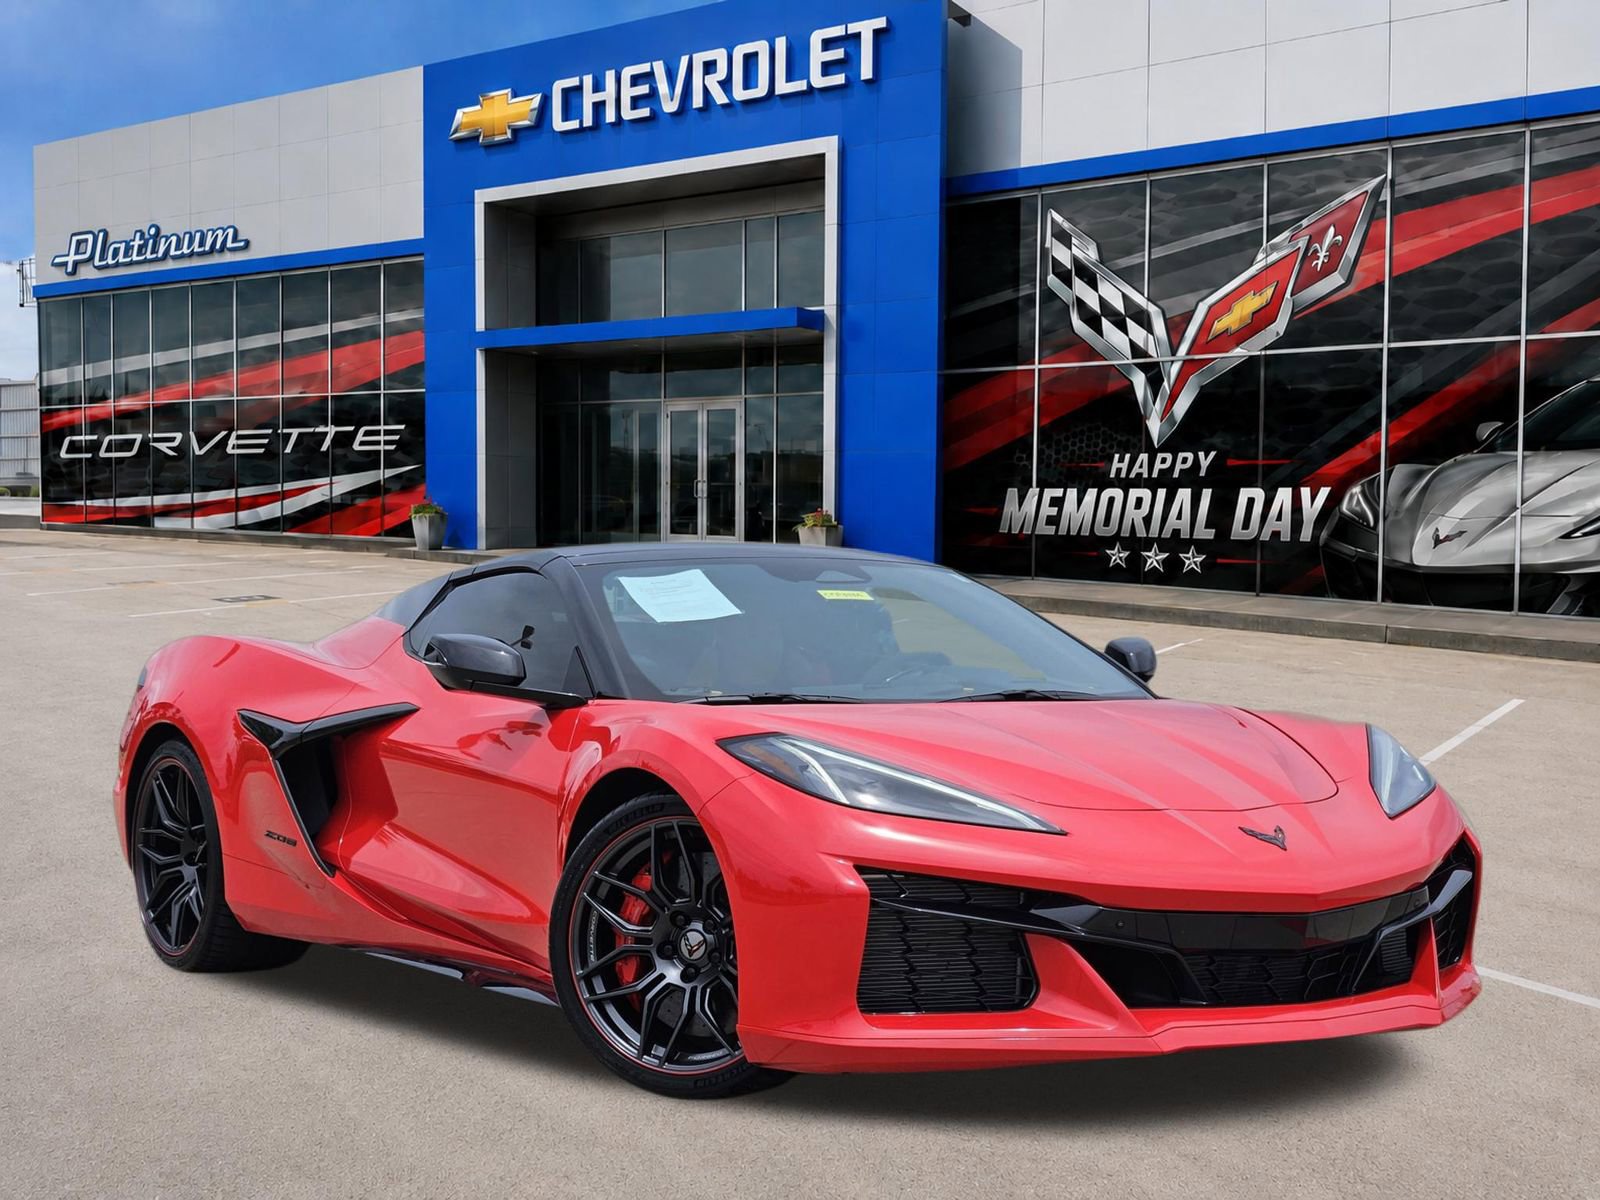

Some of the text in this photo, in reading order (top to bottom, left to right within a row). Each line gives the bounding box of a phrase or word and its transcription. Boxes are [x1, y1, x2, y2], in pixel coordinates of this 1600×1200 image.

[551, 16, 888, 132] CHEVROLET
[52, 225, 249, 275] Platinum
[59, 424, 406, 459] CORVETTE
[1109, 450, 1217, 479] HAPPY
[999, 486, 1332, 542] MEMORIAL DAY
